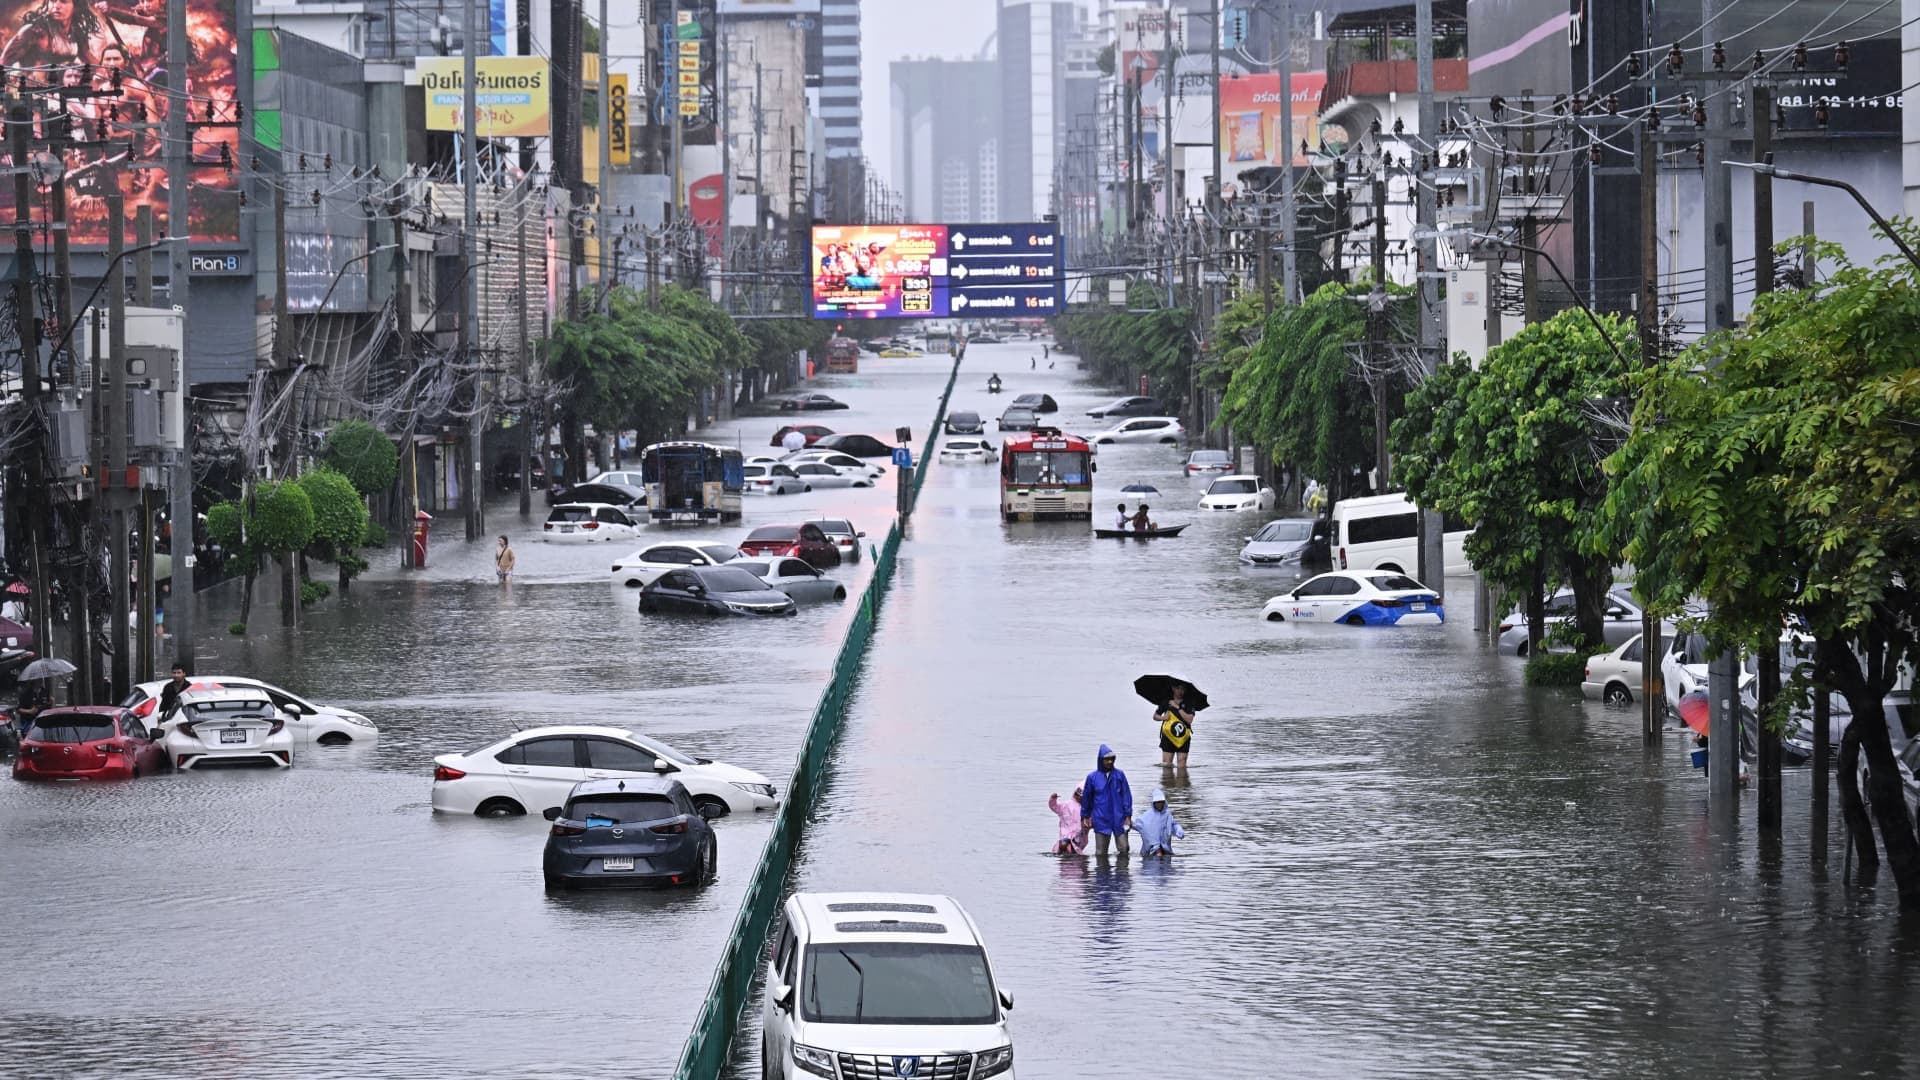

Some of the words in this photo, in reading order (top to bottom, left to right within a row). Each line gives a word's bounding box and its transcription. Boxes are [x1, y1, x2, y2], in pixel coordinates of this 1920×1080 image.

[422, 70, 541, 89] เปียโซ็นเตอร์
[1029, 235, 1037, 246] 6
[1025, 266, 1038, 277] 10
[1025, 296, 1038, 307] 16
